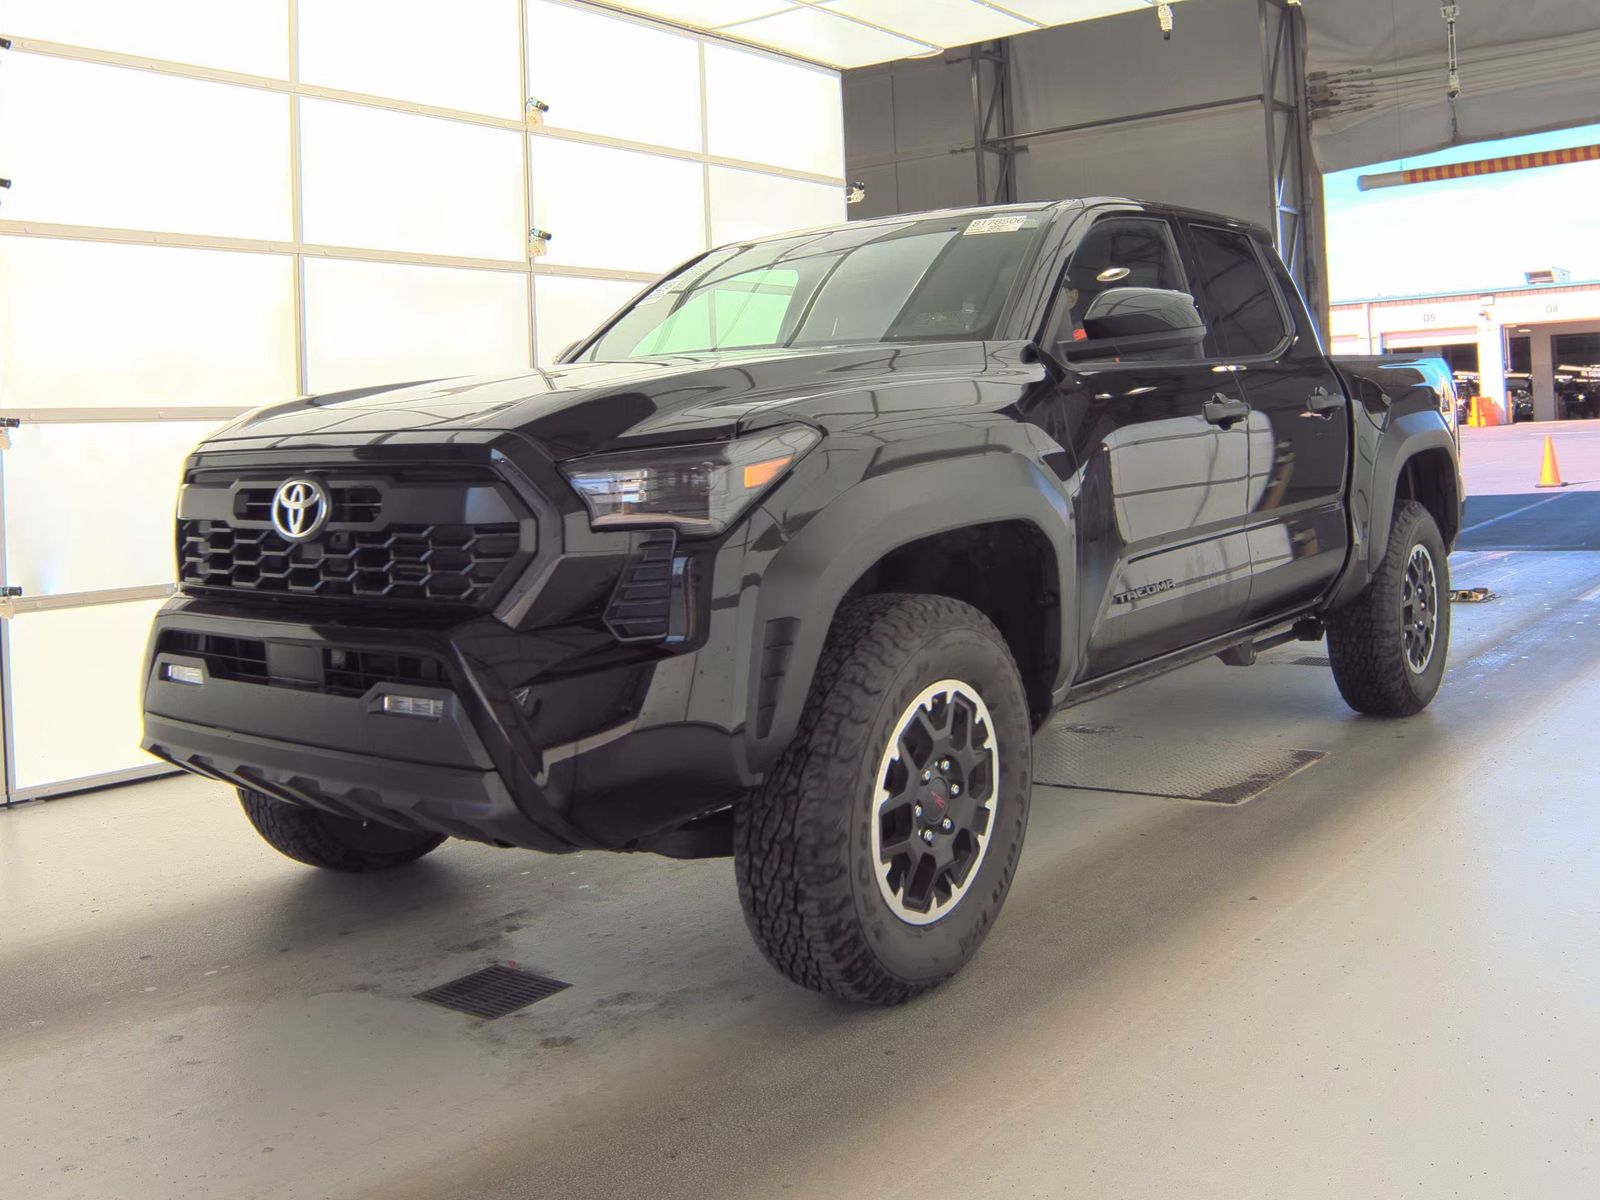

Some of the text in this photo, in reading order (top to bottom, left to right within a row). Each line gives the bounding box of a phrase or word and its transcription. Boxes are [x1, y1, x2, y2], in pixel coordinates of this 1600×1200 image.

[1545, 304, 1559, 314] D8
[1423, 313, 1436, 323] D9
[1114, 579, 1176, 603] TACOMA
